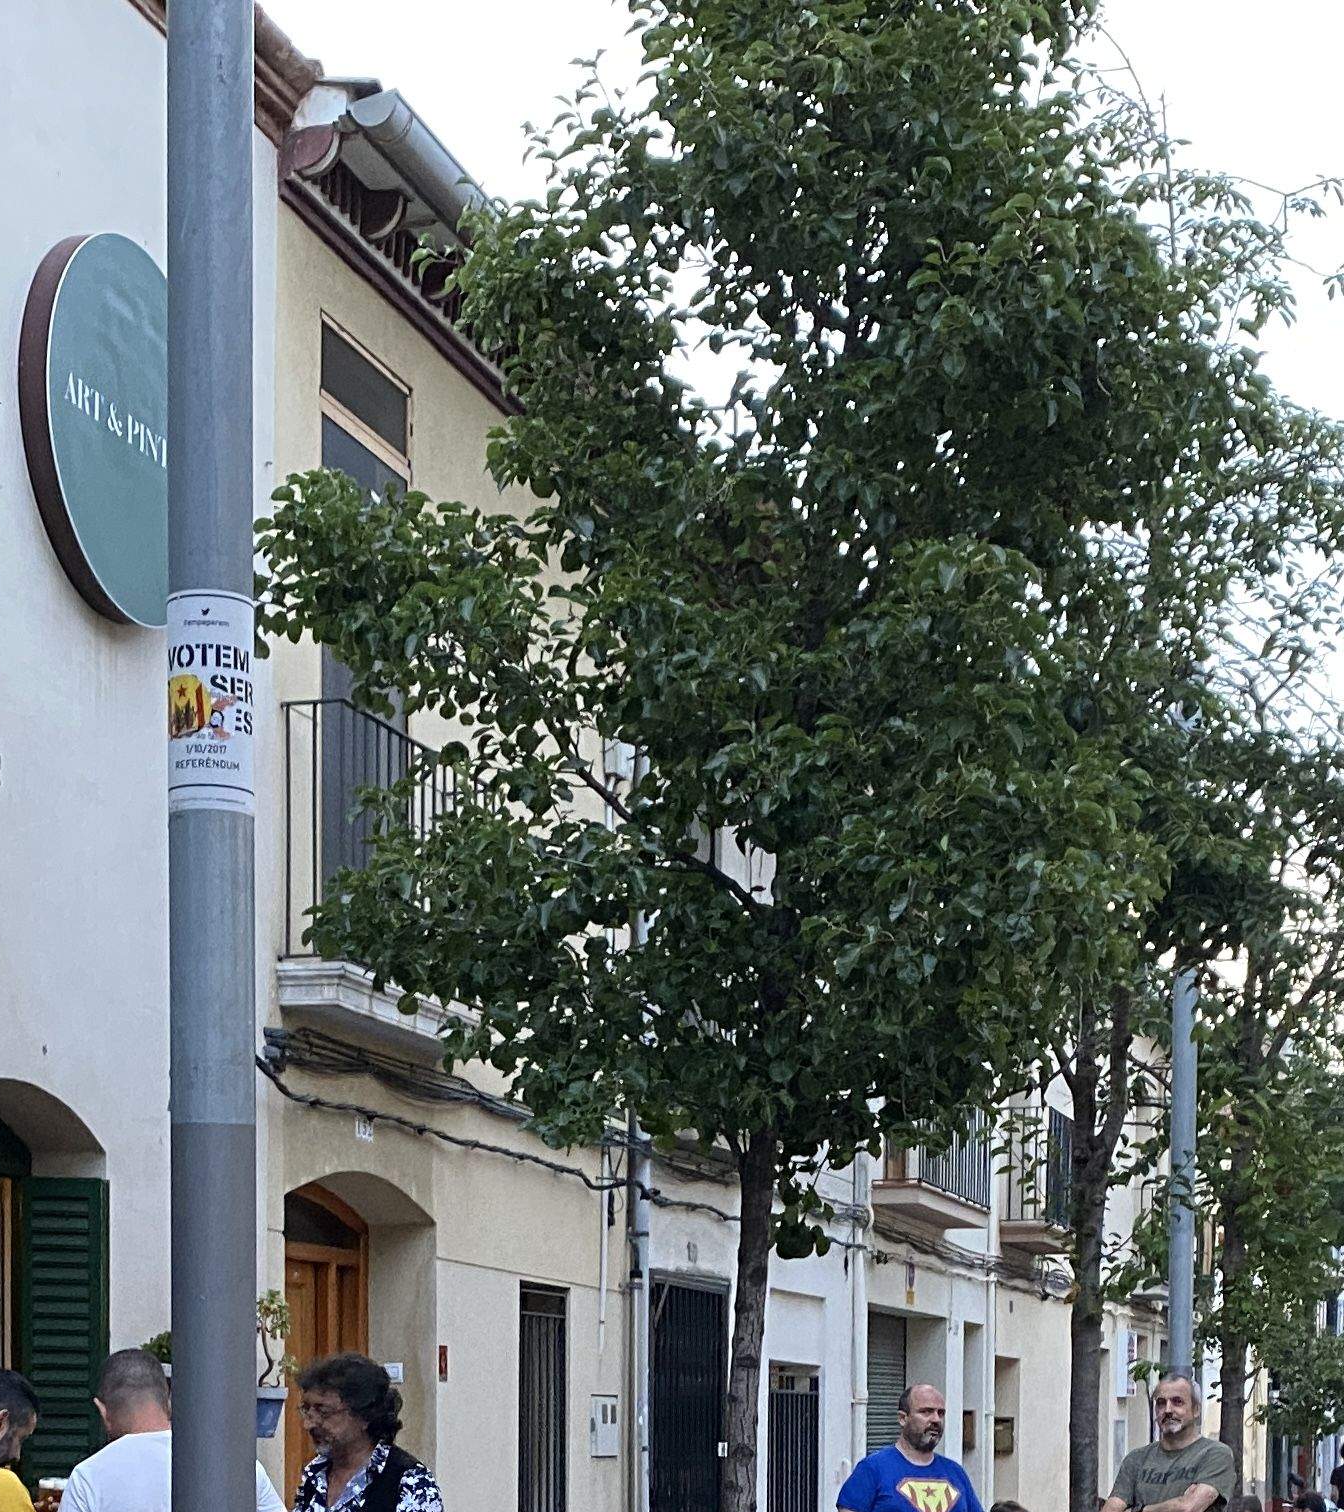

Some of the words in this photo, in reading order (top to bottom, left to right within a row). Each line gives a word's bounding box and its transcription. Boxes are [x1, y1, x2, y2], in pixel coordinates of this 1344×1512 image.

[63, 370, 106, 422] ART
[107, 401, 123, 437] &
[168, 643, 250, 674] VOTEM
[210, 674, 254, 707] SER
[185, 743, 227, 756] 1/10/2017
